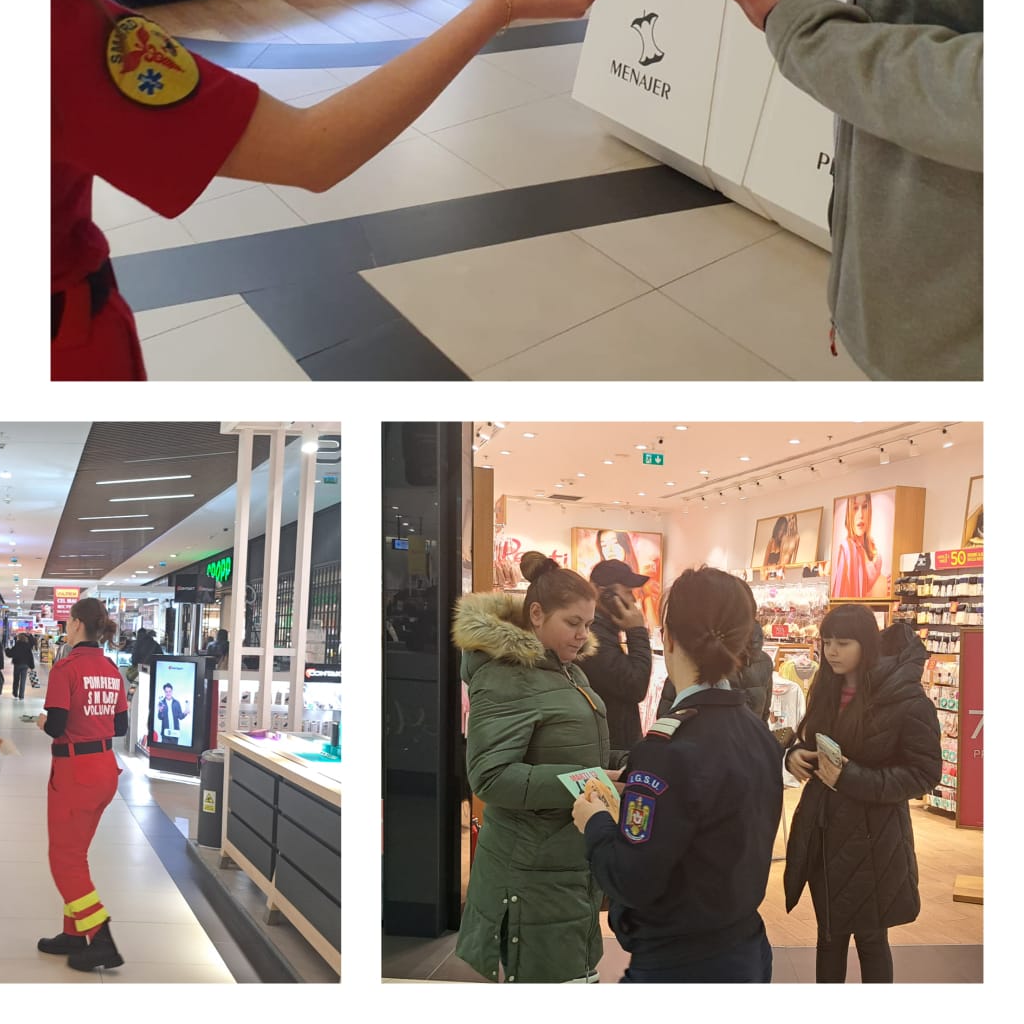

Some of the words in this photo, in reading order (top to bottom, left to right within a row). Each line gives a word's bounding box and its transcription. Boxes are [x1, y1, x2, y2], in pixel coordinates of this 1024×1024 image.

[610, 59, 672, 100] MENAJER
[498, 538, 568, 566] Peti
[950, 550, 967, 566] 50
